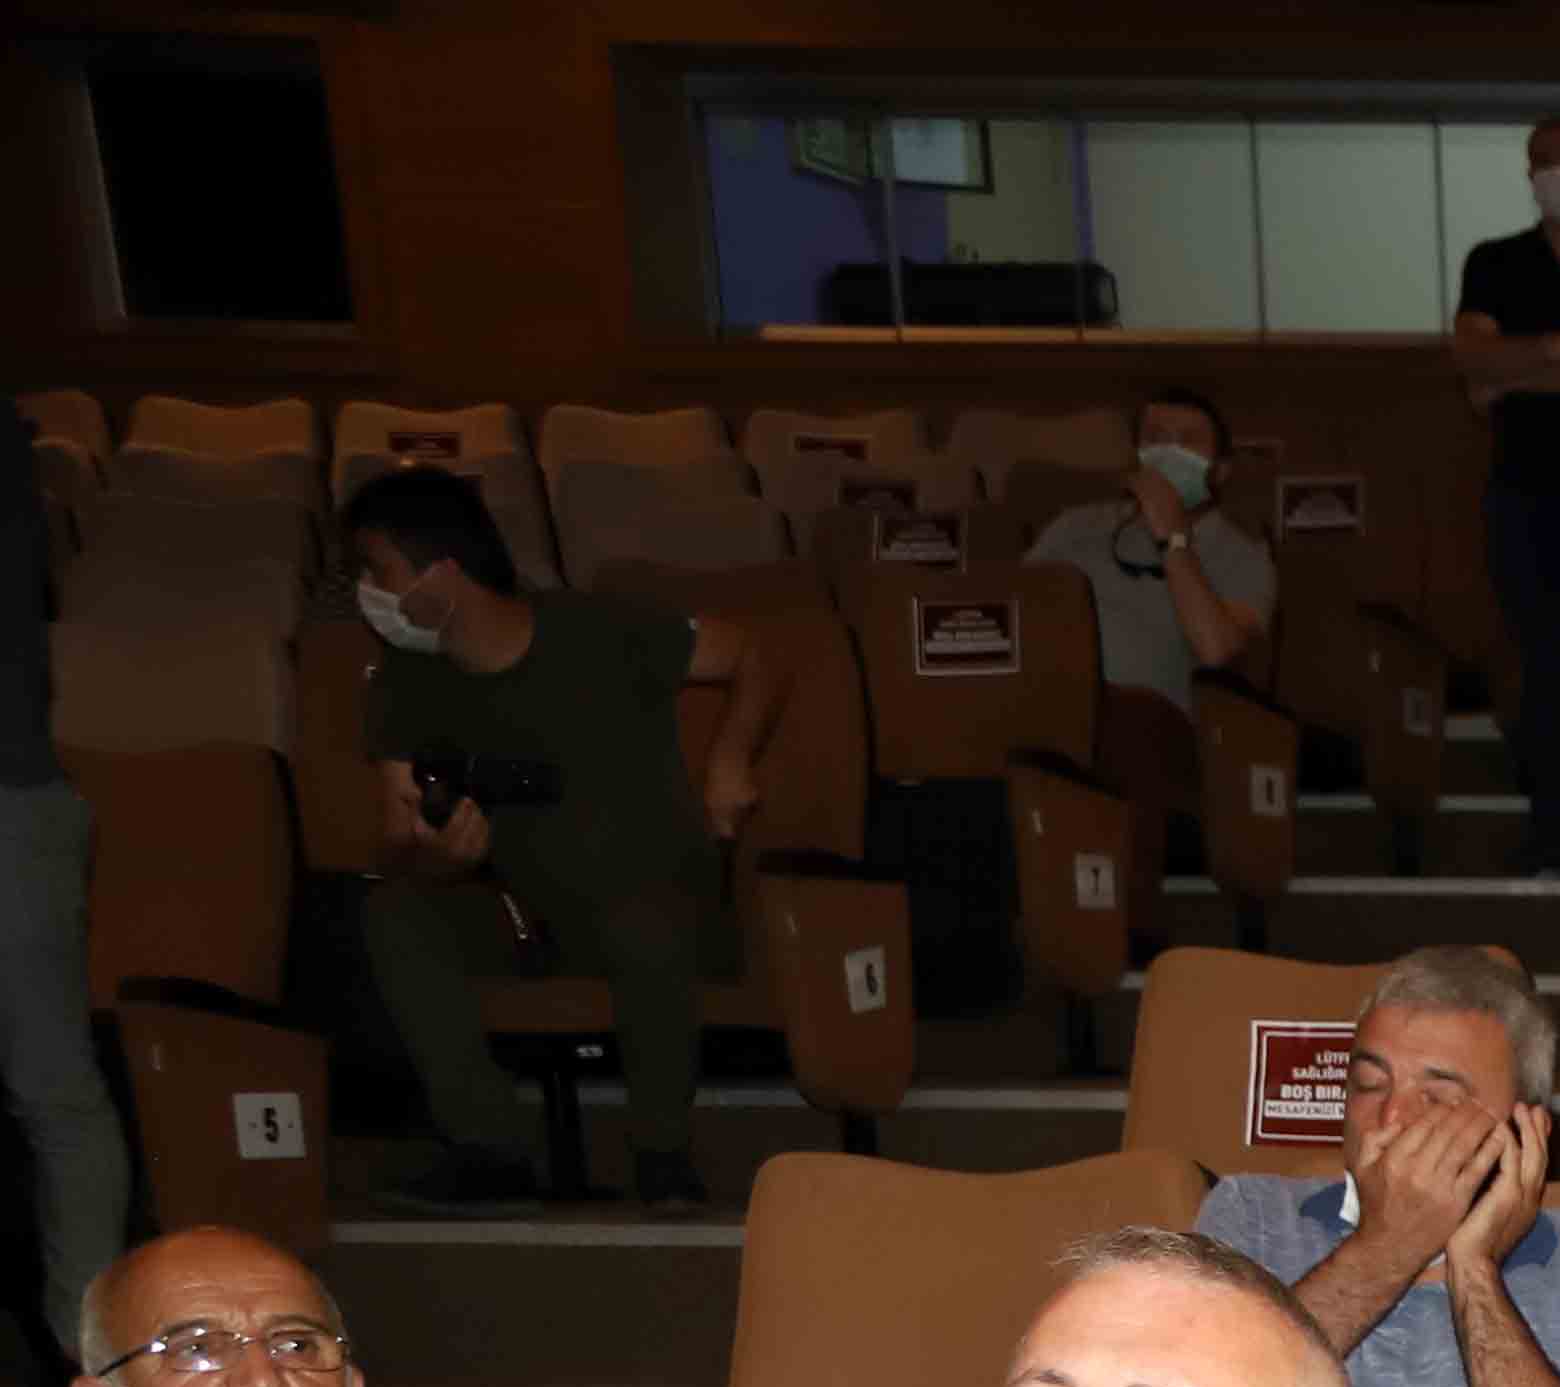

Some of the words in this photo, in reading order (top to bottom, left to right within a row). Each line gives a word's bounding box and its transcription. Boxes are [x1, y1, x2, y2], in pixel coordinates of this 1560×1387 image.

[865, 962, 878, 996] 6
[1317, 1051, 1350, 1064] LÜTF
[1281, 1084, 1312, 1102] BOŞ
[264, 1105, 279, 1143] 5
